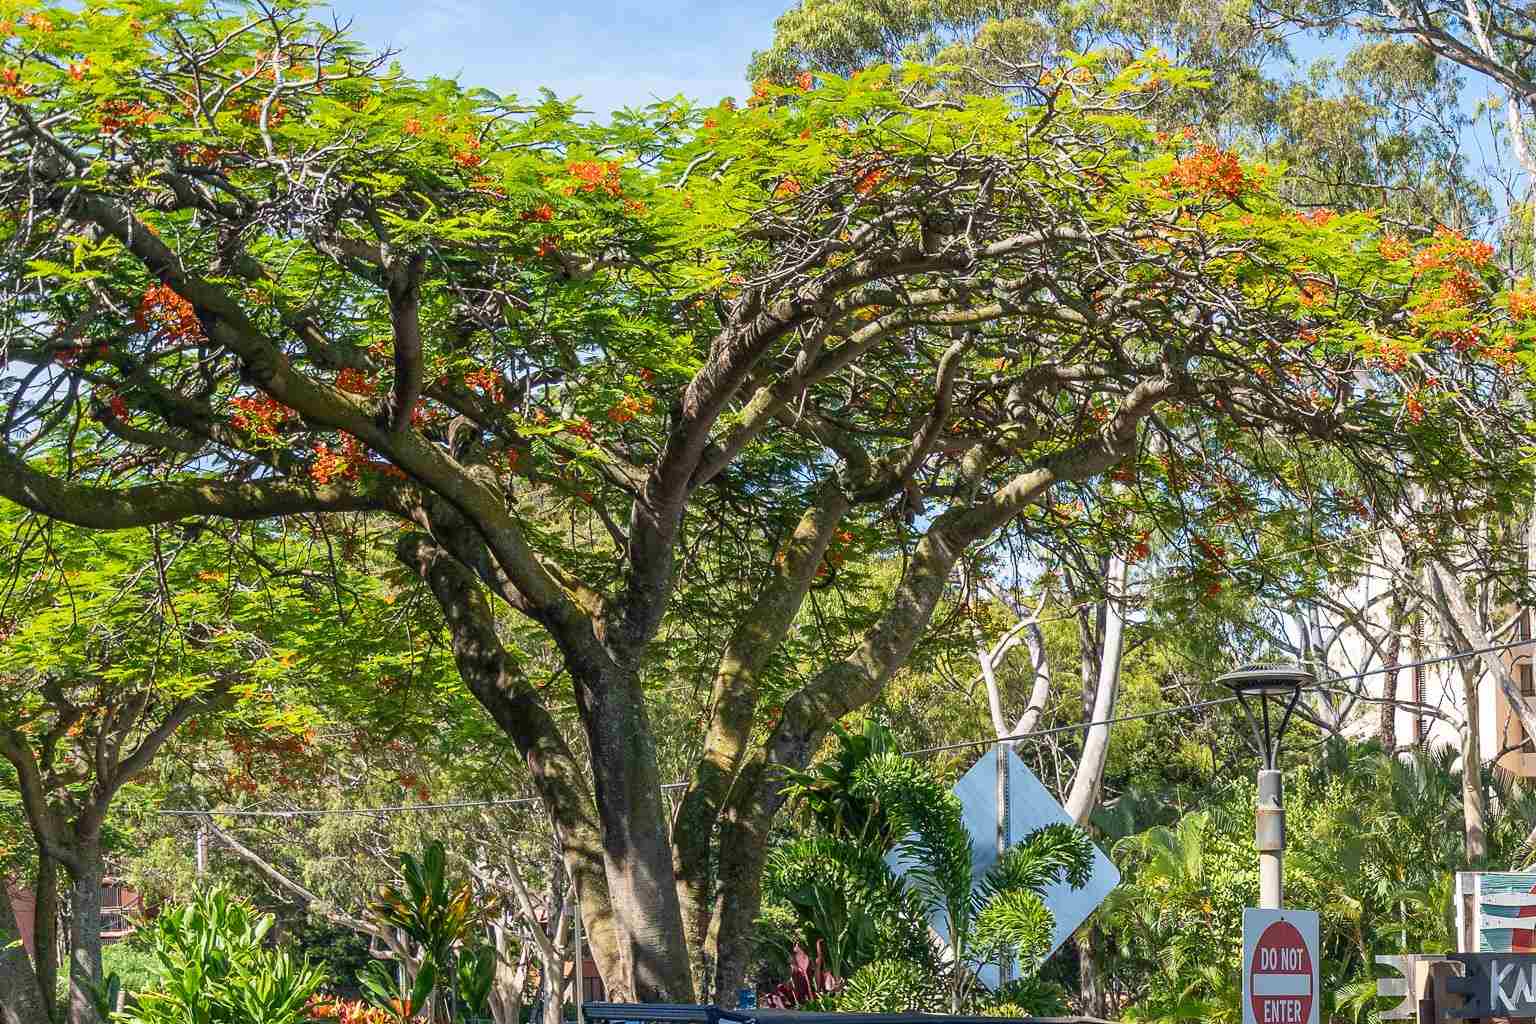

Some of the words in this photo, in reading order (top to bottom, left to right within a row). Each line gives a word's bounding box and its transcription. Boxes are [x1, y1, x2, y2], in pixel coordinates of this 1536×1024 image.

[1261, 948, 1278, 970] DO
[1281, 948, 1303, 970] NOT
[1263, 999, 1303, 1023] ENTER
